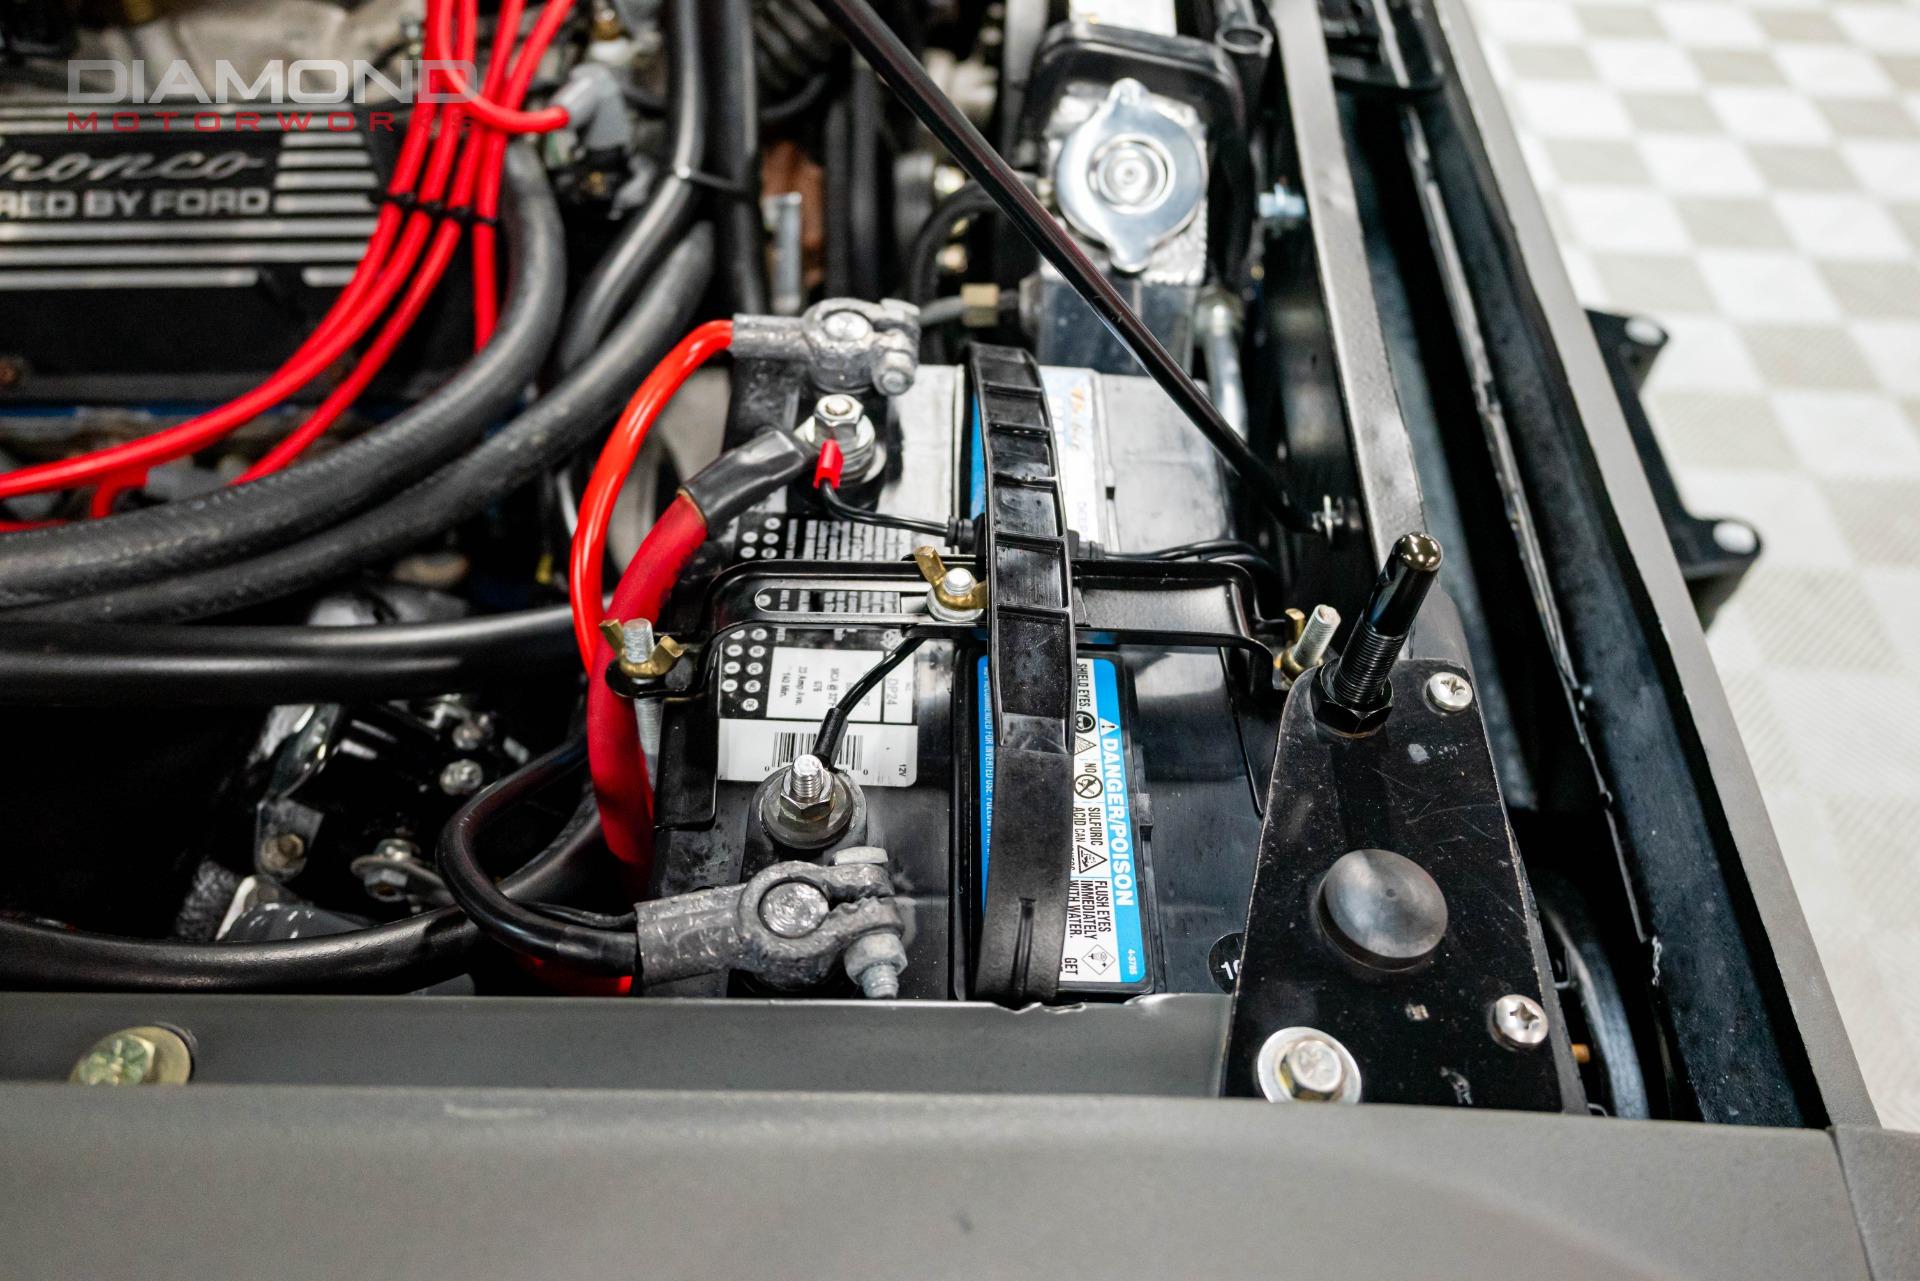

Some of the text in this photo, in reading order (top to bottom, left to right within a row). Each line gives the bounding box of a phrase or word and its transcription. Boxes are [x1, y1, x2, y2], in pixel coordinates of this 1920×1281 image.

[0, 150, 266, 183] ronco
[83, 189, 144, 217] BY
[152, 186, 271, 216] FORD
[1077, 663, 1091, 709] SHIELD EYES.
[985, 731, 993, 744] FOR
[898, 763, 907, 777] 12V
[985, 746, 993, 778] INVERTED
[1084, 763, 1097, 773] NO
[1073, 807, 1087, 843] ACID CAN
[1088, 807, 1104, 846] SULFURIC
[1102, 738, 1135, 906] DANGER/POISON
[1067, 880, 1080, 902] WITH
[1094, 880, 1112, 933] FLUSH EYES
[1067, 904, 1083, 938] WATER.
[1080, 880, 1098, 940] IMMEDIATELY
[1064, 957, 1078, 975] GET
